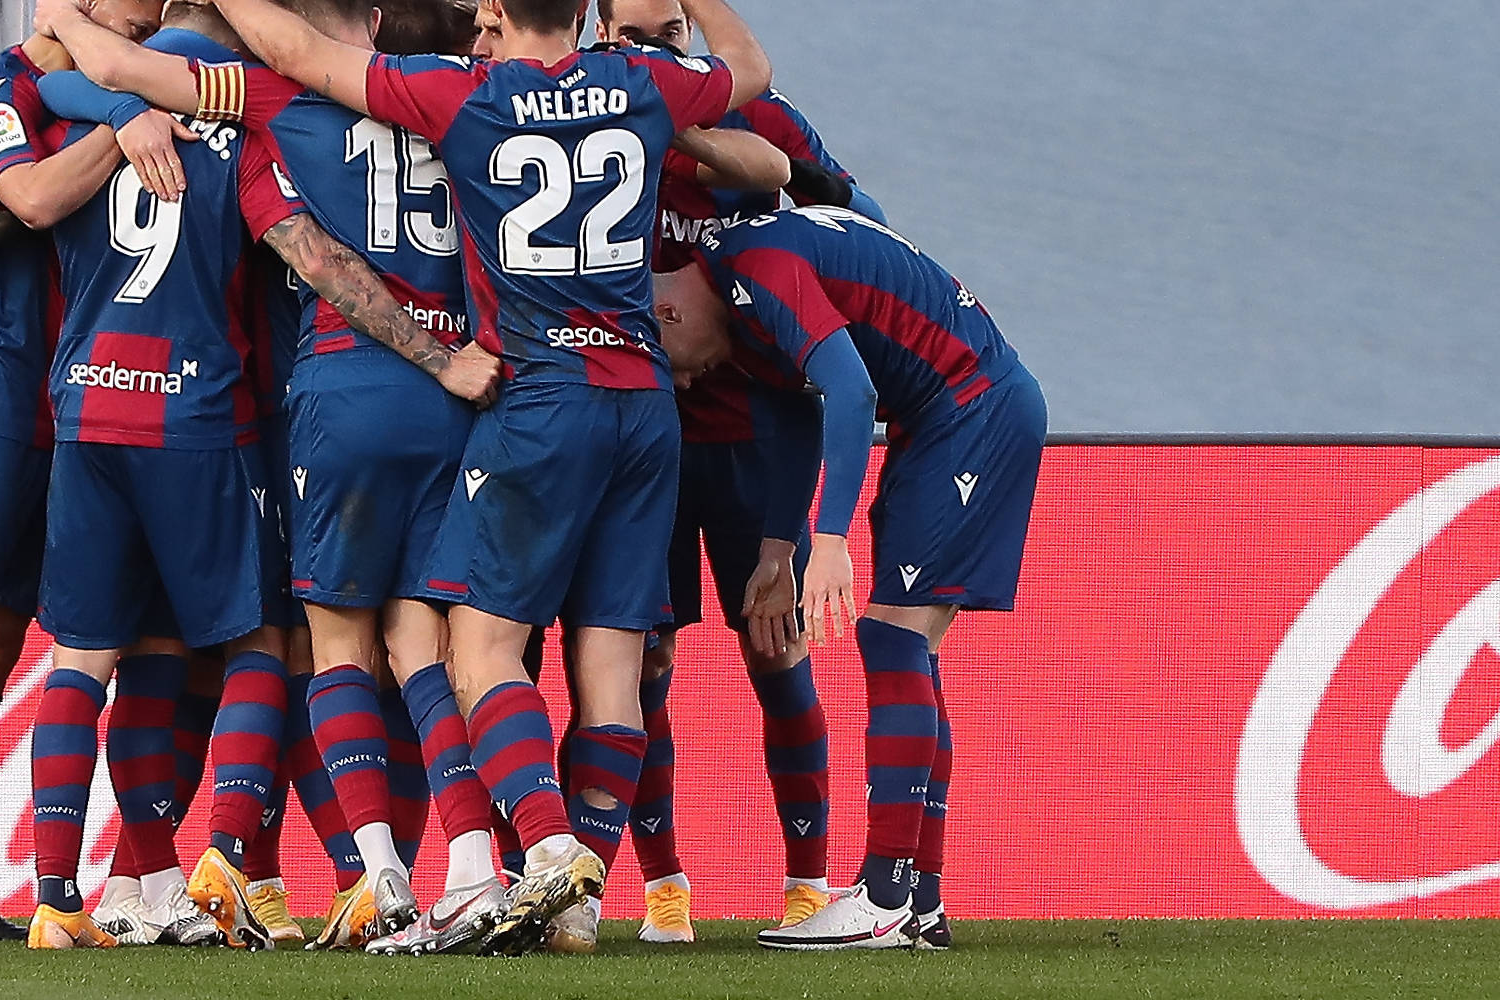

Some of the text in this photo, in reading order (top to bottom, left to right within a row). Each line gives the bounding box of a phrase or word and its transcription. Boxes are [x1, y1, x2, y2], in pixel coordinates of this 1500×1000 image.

[510, 87, 628, 126] MELERO
[108, 162, 185, 304] 9
[344, 116, 459, 257] 15
[488, 128, 646, 276] 22
[66, 360, 182, 395] sesderma
